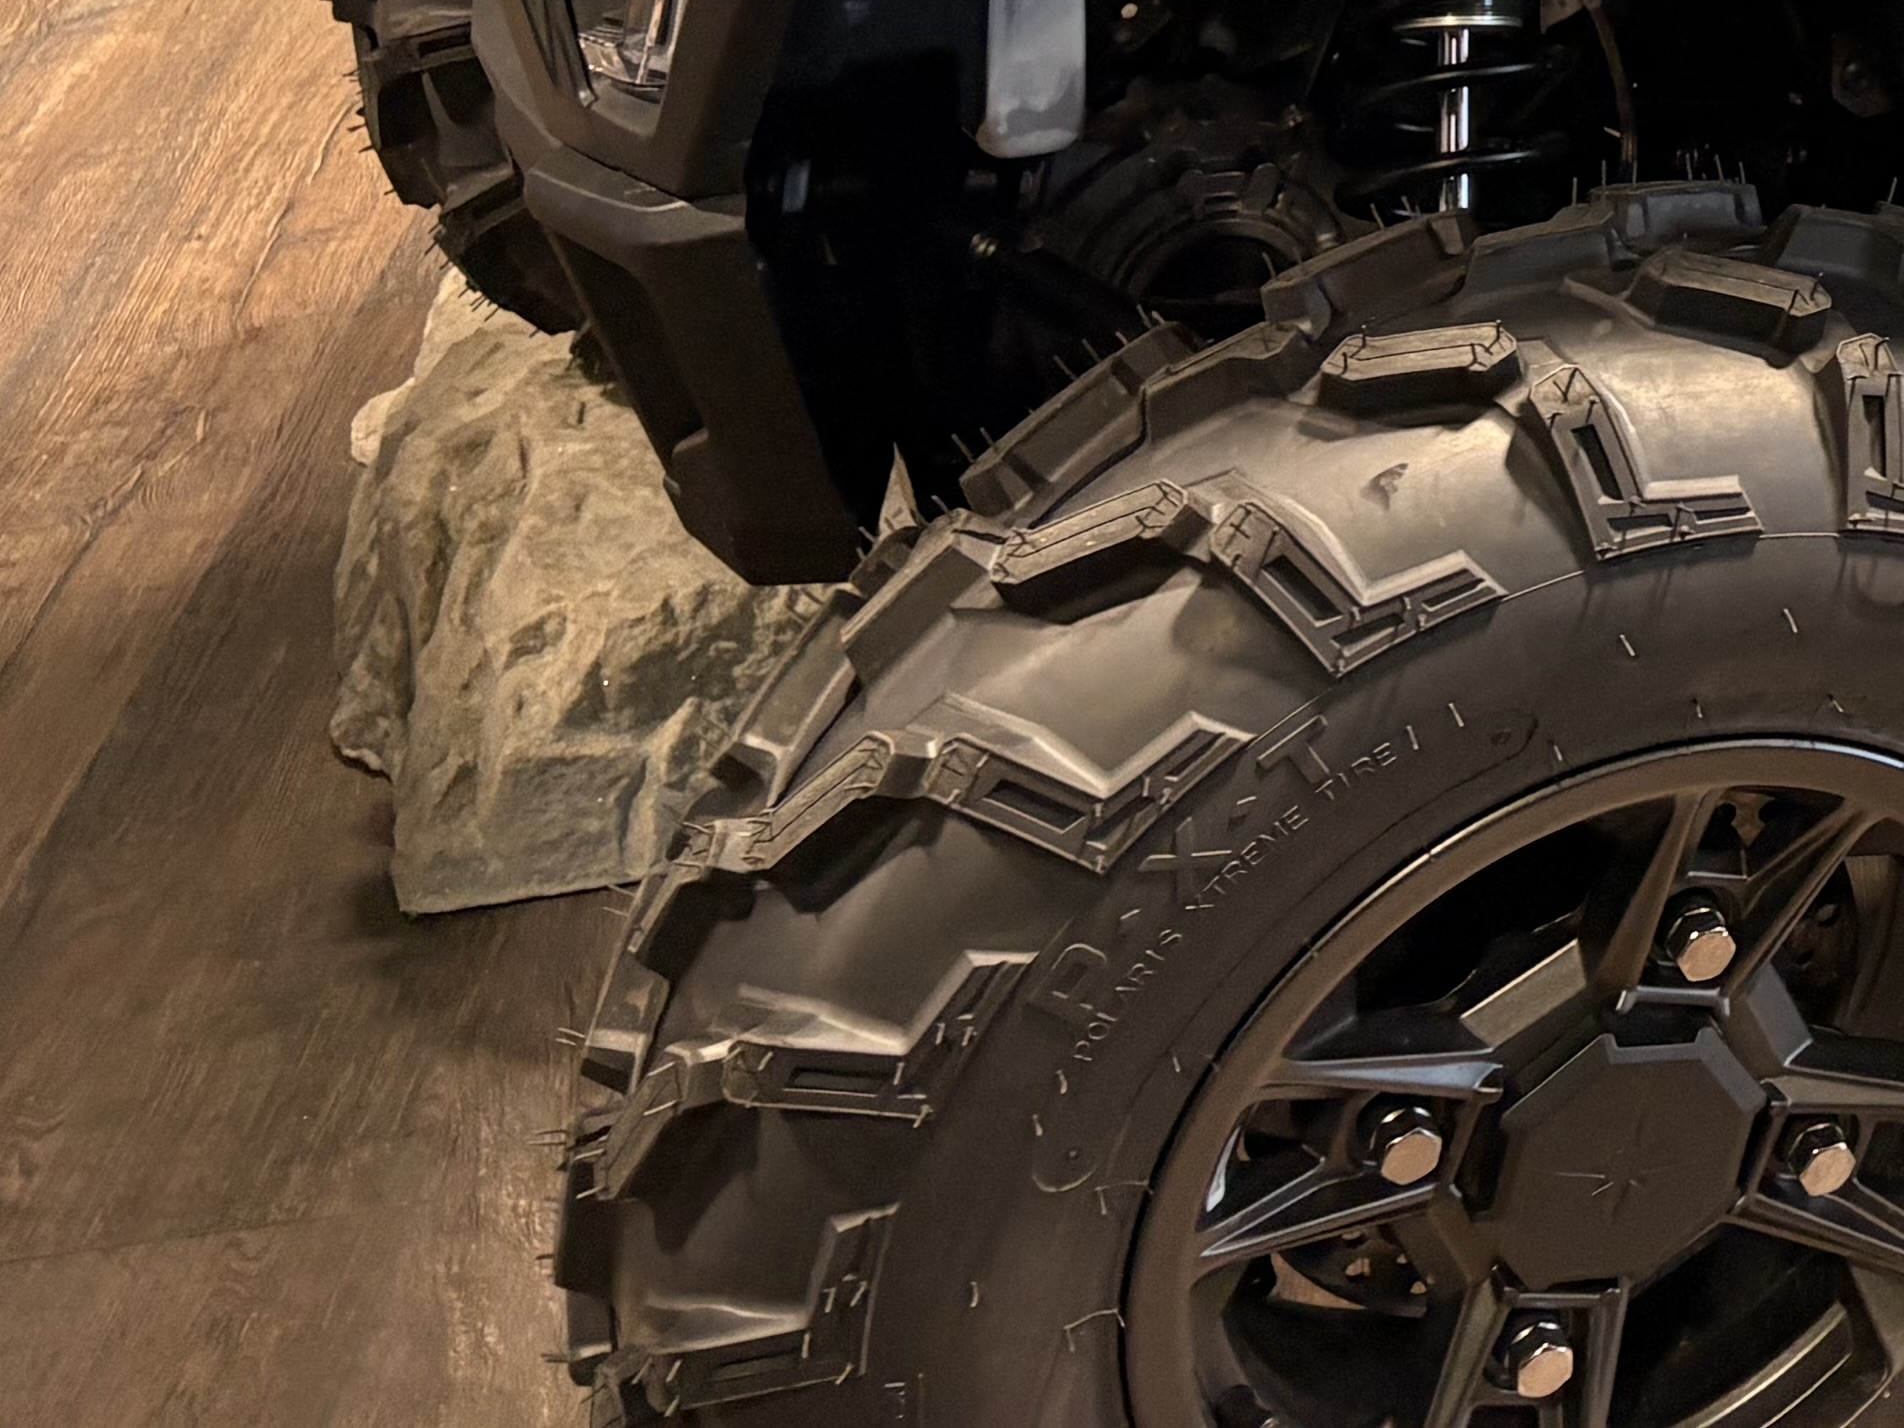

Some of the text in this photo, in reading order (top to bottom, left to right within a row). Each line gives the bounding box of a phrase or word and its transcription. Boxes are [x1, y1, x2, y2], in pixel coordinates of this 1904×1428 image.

[1072, 741, 1398, 1062] POLARIS XTREME TIRE
